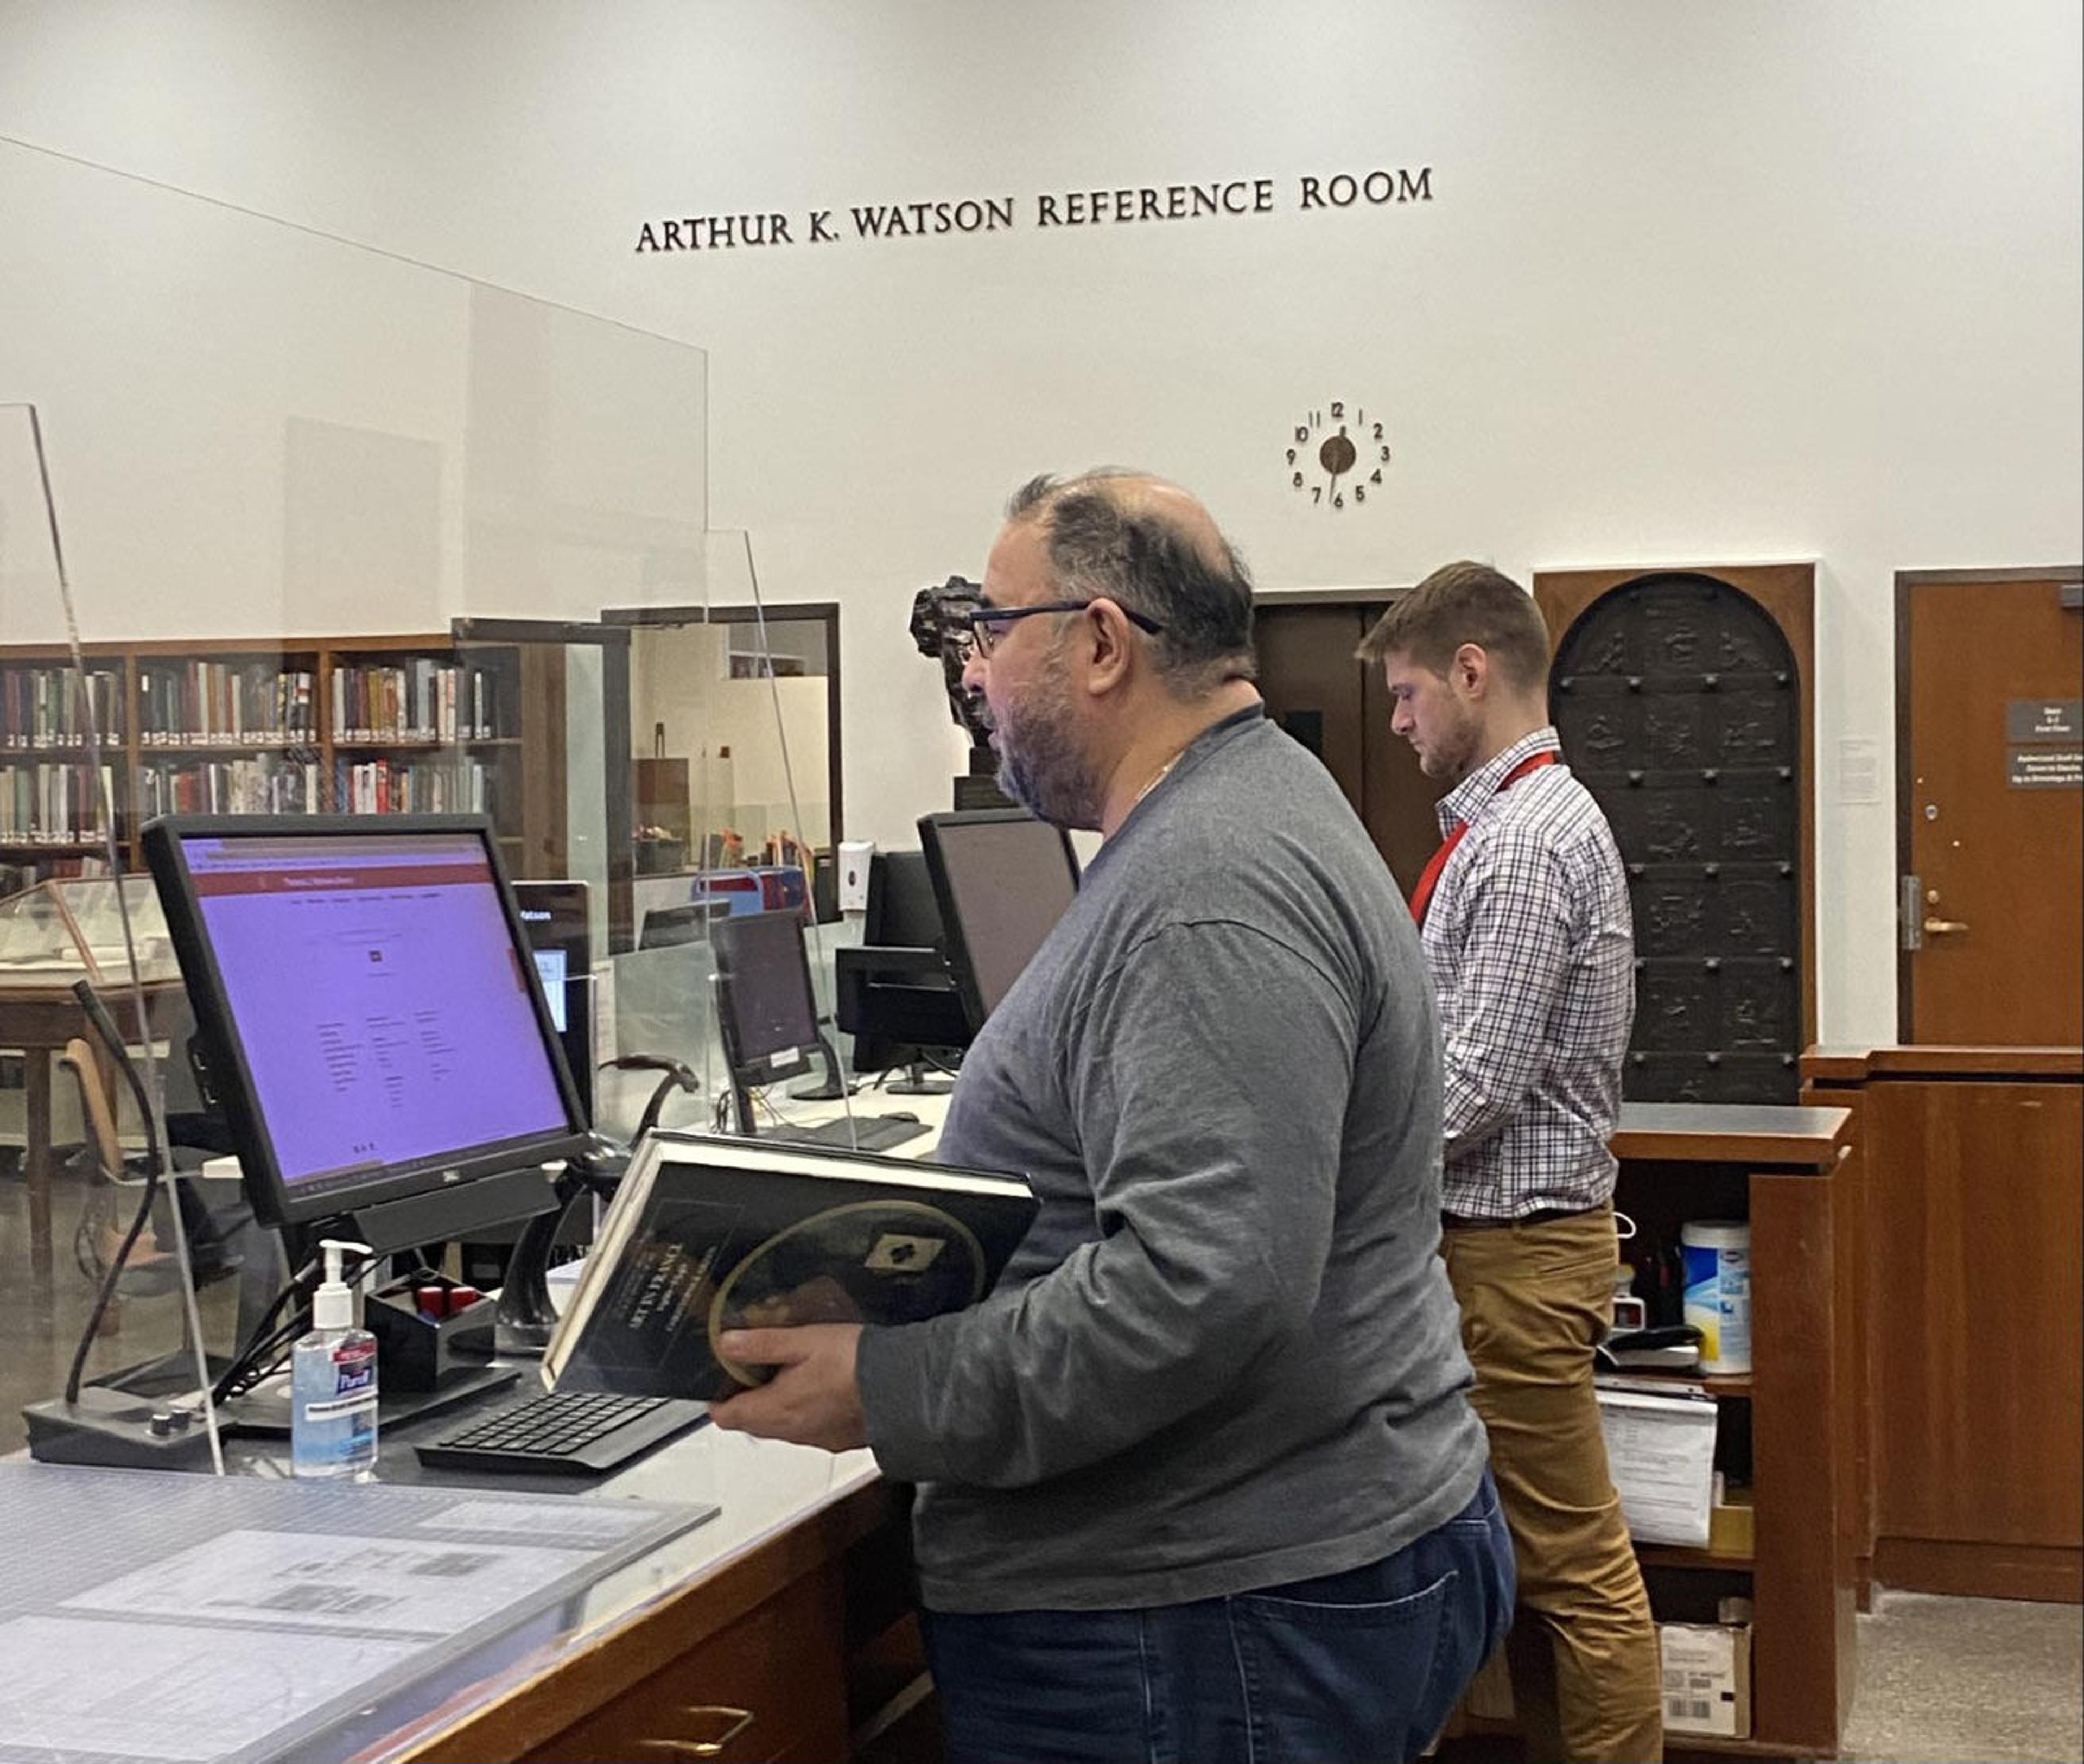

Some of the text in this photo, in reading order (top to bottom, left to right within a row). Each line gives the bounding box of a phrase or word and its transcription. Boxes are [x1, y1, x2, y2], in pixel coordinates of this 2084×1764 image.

[635, 168, 1432, 253] ARTHUR K. WATSON REFERENCE ROOM
[1331, 401, 1344, 418] 12
[1295, 426, 1309, 443] 10
[1373, 422, 1383, 440] 2
[1286, 449, 1297, 466] 9
[1381, 446, 1391, 462] 3
[1293, 471, 1304, 488] 8
[1370, 468, 1383, 485] 4
[1311, 486, 1322, 504] 7
[1333, 492, 1344, 509] 6
[1355, 485, 1365, 502] 5
